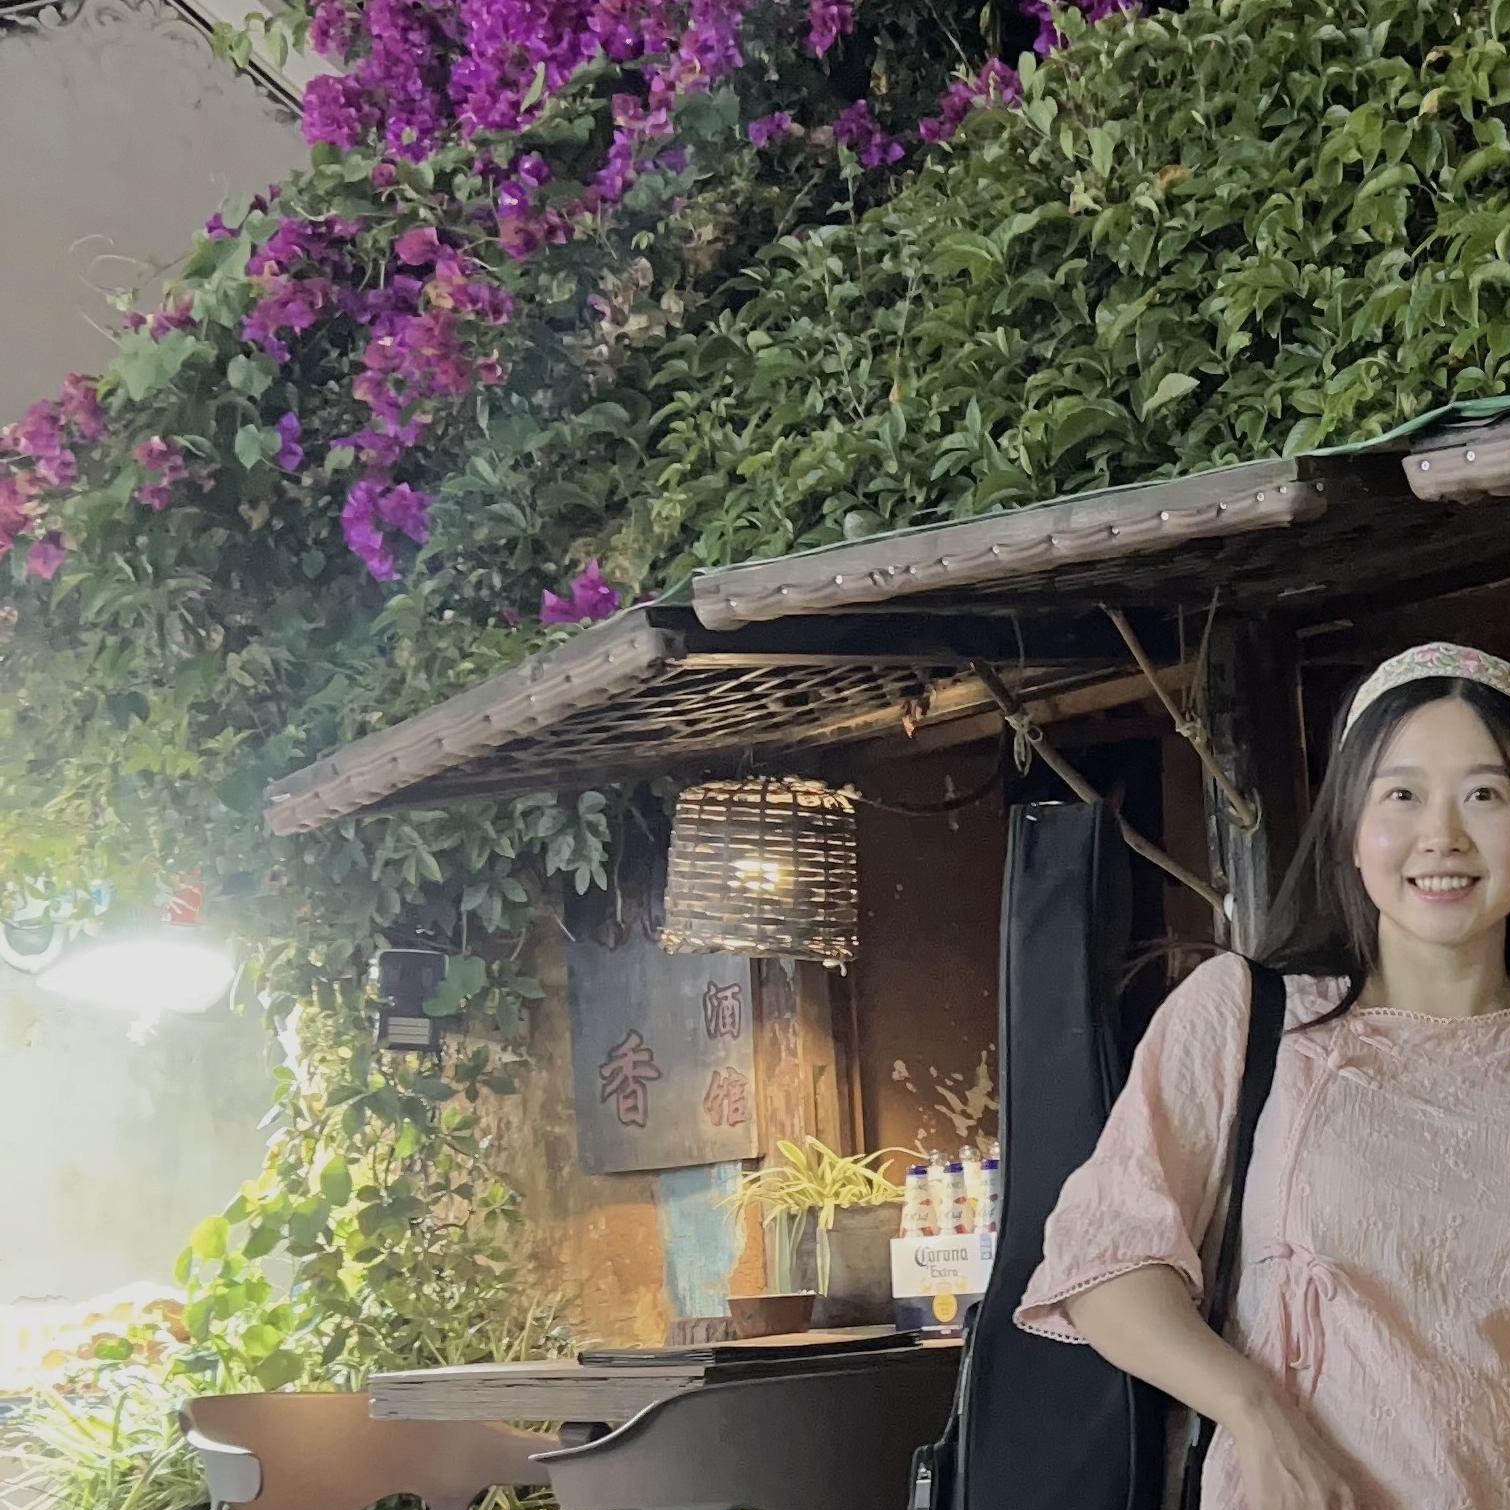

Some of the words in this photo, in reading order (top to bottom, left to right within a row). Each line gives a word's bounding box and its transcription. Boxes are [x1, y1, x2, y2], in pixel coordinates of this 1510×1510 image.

[599, 1028, 663, 1128] 香
[703, 980, 749, 1127] 酒馆
[914, 1245, 969, 1268] Corona
[930, 1265, 959, 1278] Extra
